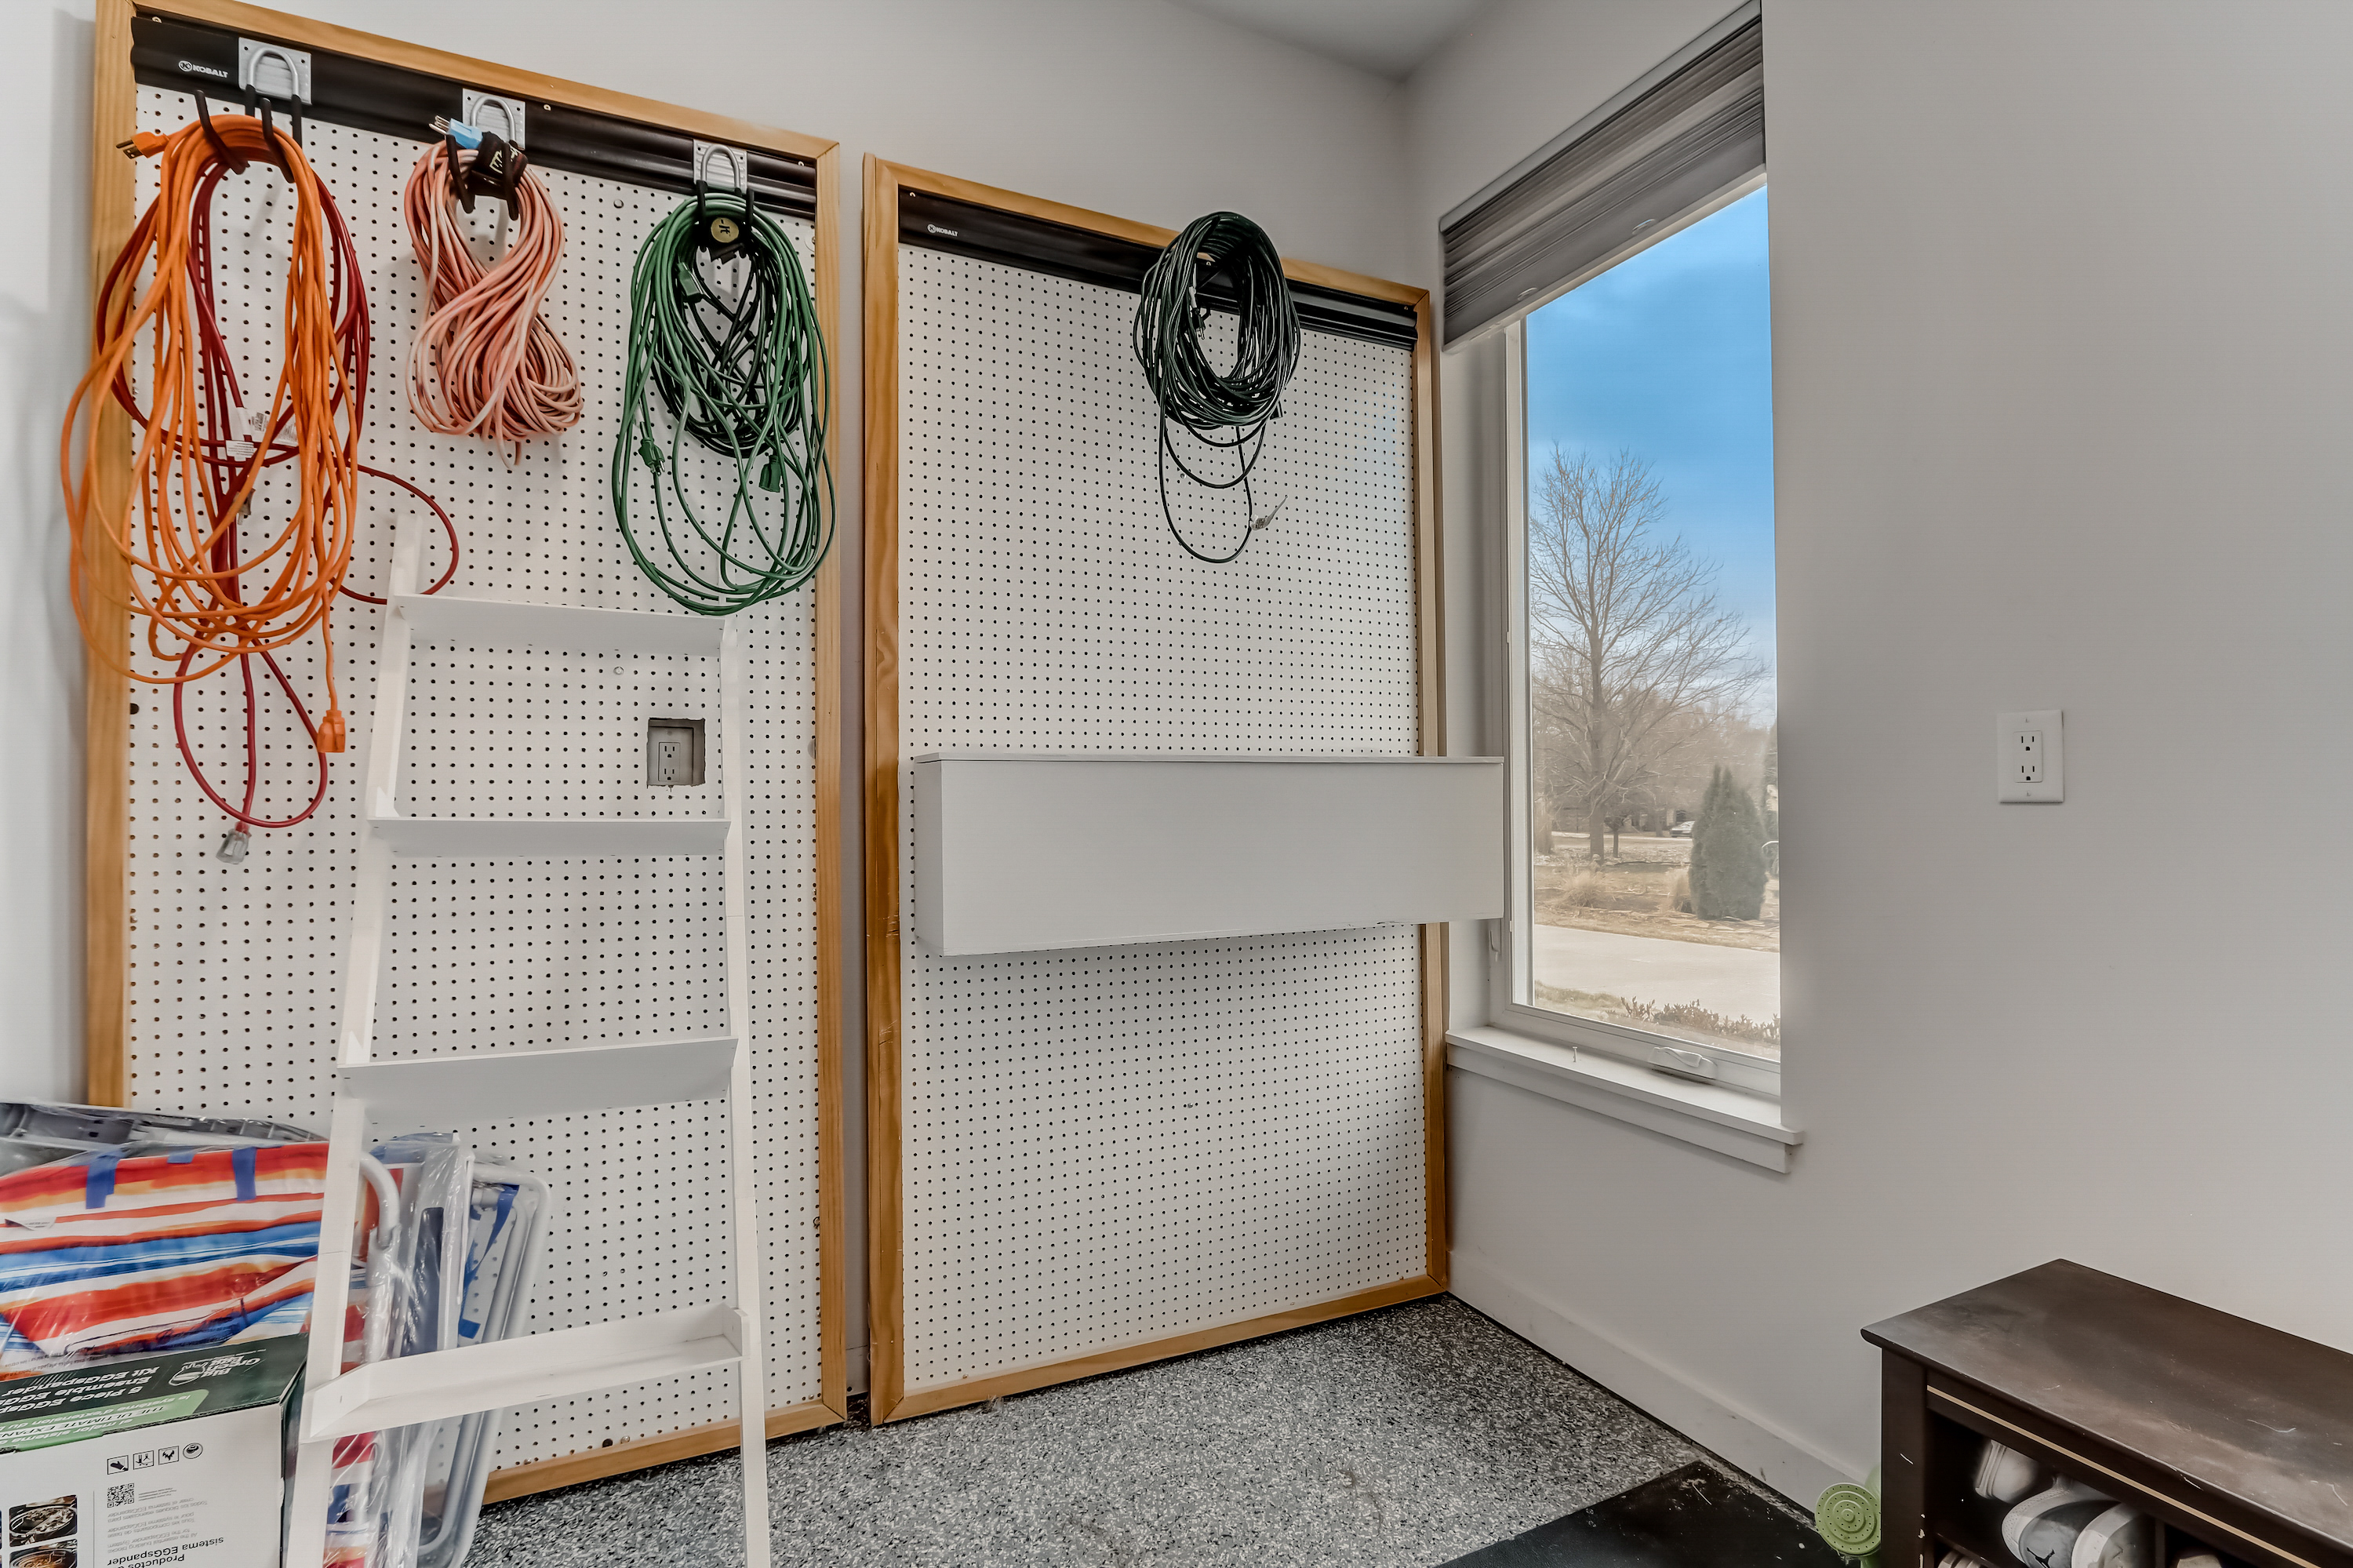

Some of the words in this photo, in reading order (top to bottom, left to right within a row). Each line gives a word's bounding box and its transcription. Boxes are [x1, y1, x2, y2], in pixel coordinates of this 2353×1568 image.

[192, 64, 228, 78] KOBALT
[132, 1366, 160, 1377] Kit
[201, 1368, 231, 1378] Big
[2, 1371, 129, 1397] EGGspander
[54, 1376, 152, 1396] Ensemble
[70, 1388, 126, 1402] Piece
[0, 1425, 56, 1438] EXPAN
[11, 1430, 71, 1442] sistema
[182, 1537, 224, 1550] sistema
[107, 1546, 178, 1566] EGGspander
[129, 1555, 184, 1568] Productos
